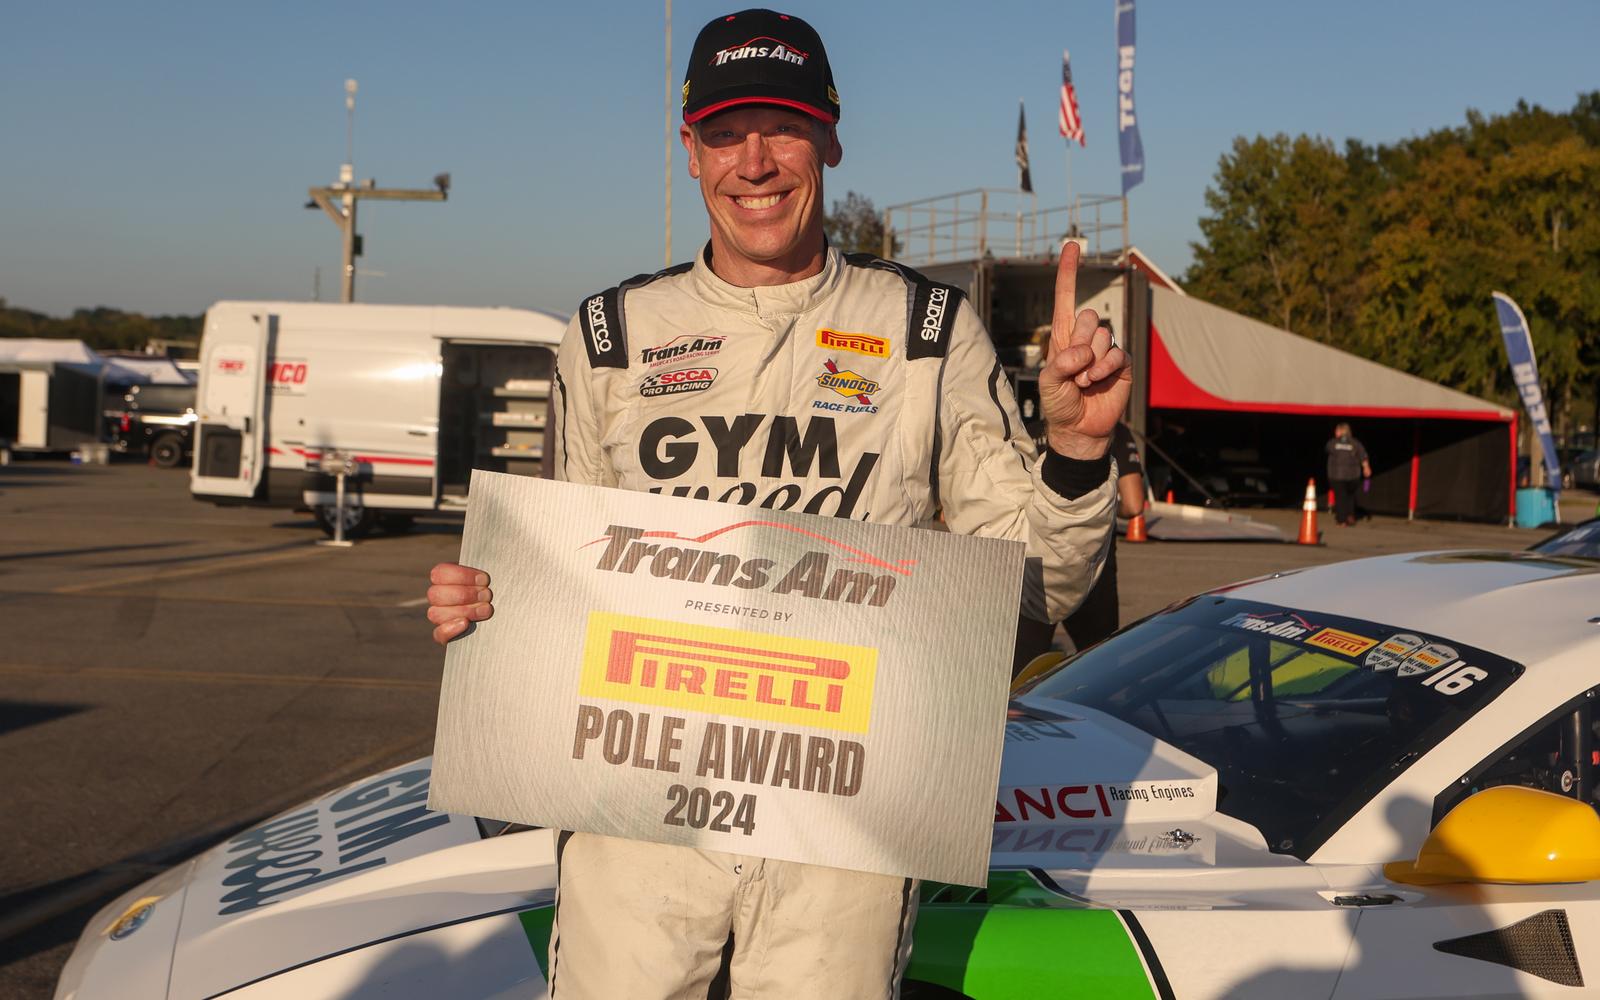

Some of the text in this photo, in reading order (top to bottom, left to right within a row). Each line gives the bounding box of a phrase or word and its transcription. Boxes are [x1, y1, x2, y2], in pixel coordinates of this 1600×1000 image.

[715, 44, 804, 67] Trans Am
[587, 296, 612, 354] sparco
[921, 288, 949, 343] sparco
[641, 339, 723, 364] Trans Am
[821, 330, 884, 354] PIRELLI
[642, 382, 710, 396] PRO RACING
[660, 370, 712, 384] SCCA
[820, 375, 876, 393] SUNOCO
[812, 400, 878, 414] RACE FUELS
[638, 413, 841, 480] GYM
[596, 524, 896, 608] Trans Am
[684, 599, 793, 622] PRESENTED BY
[1313, 632, 1369, 652] PIRELLI
[605, 630, 850, 713] PIRELLI
[1421, 660, 1489, 695] 16
[572, 704, 866, 797] POLE AWARD
[1109, 785, 1150, 802] Racing
[1150, 784, 1195, 801] Engines
[663, 784, 757, 836] 2024
